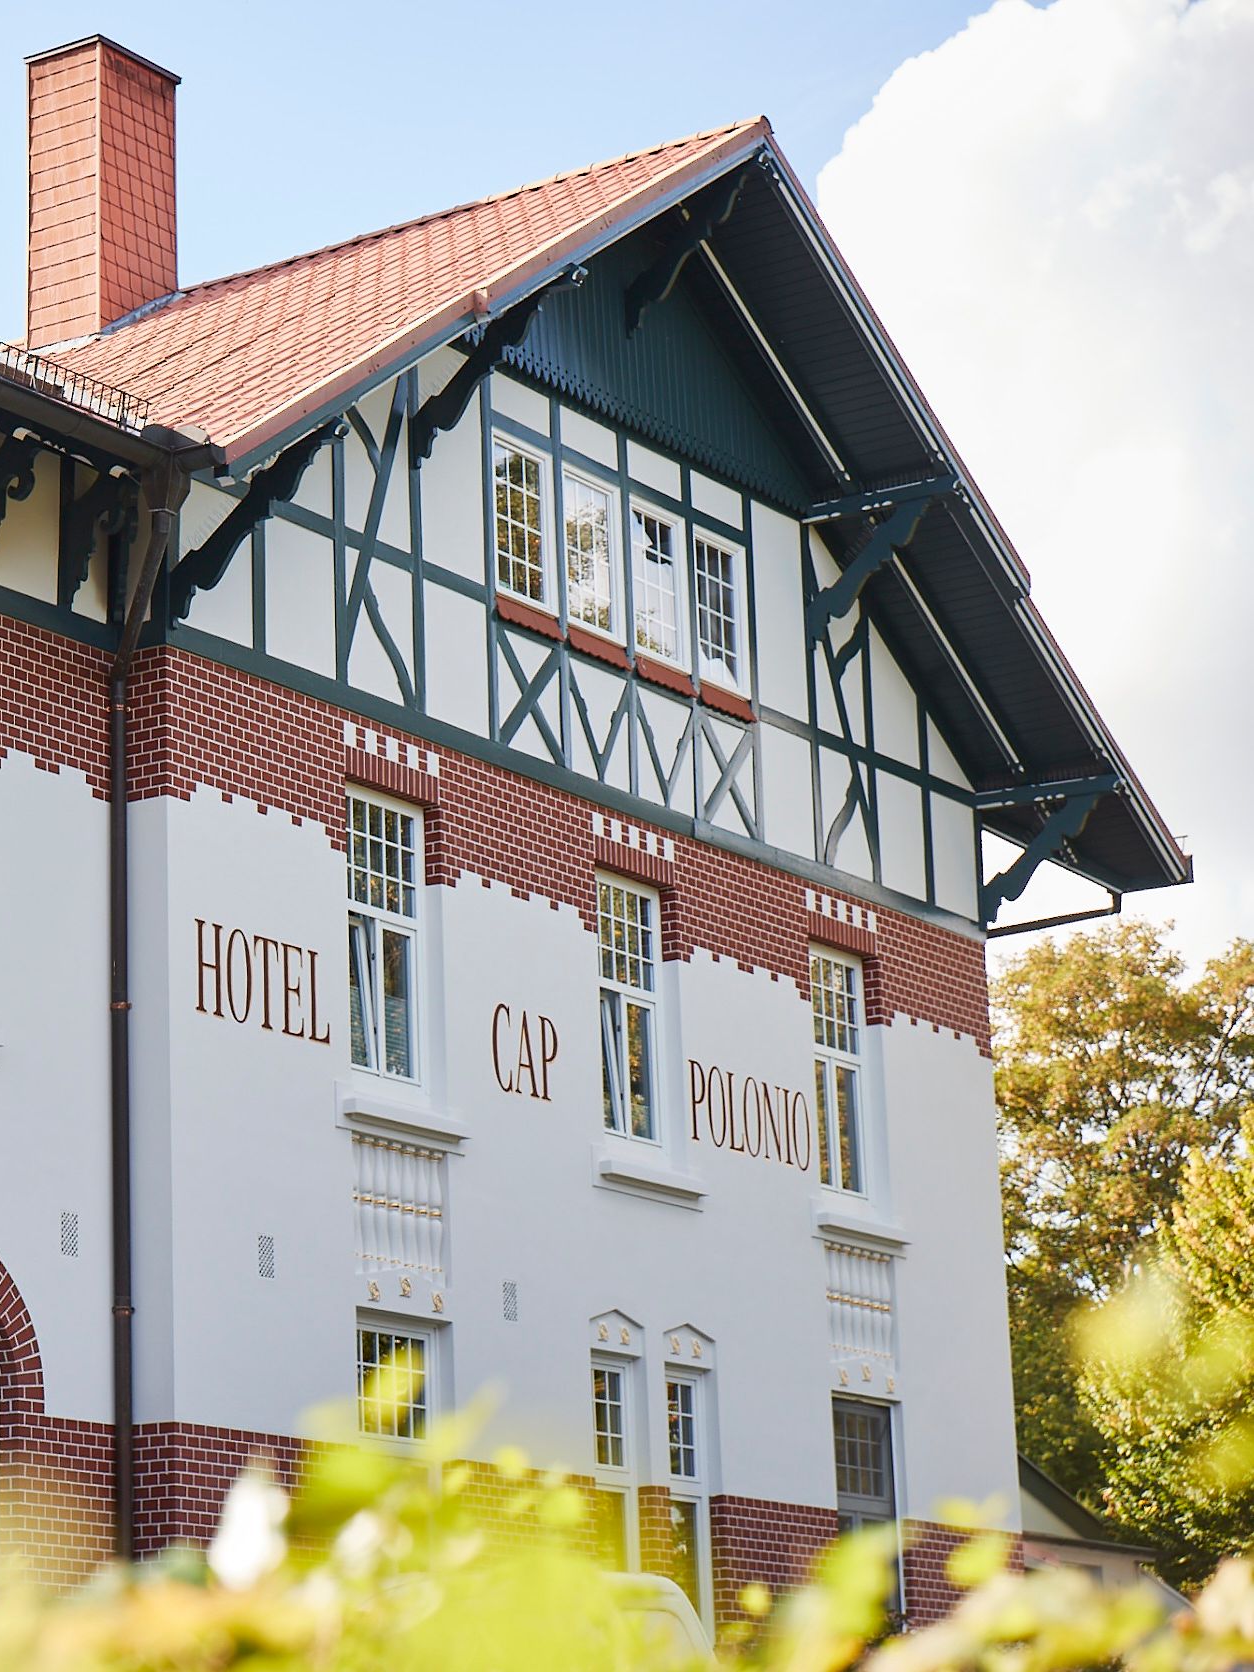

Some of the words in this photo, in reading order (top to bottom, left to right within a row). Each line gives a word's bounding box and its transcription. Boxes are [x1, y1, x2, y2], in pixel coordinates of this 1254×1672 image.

[194, 917, 332, 1046] HOTEL
[491, 1003, 559, 1102] CAP
[687, 1058, 812, 1172] POLONIO
